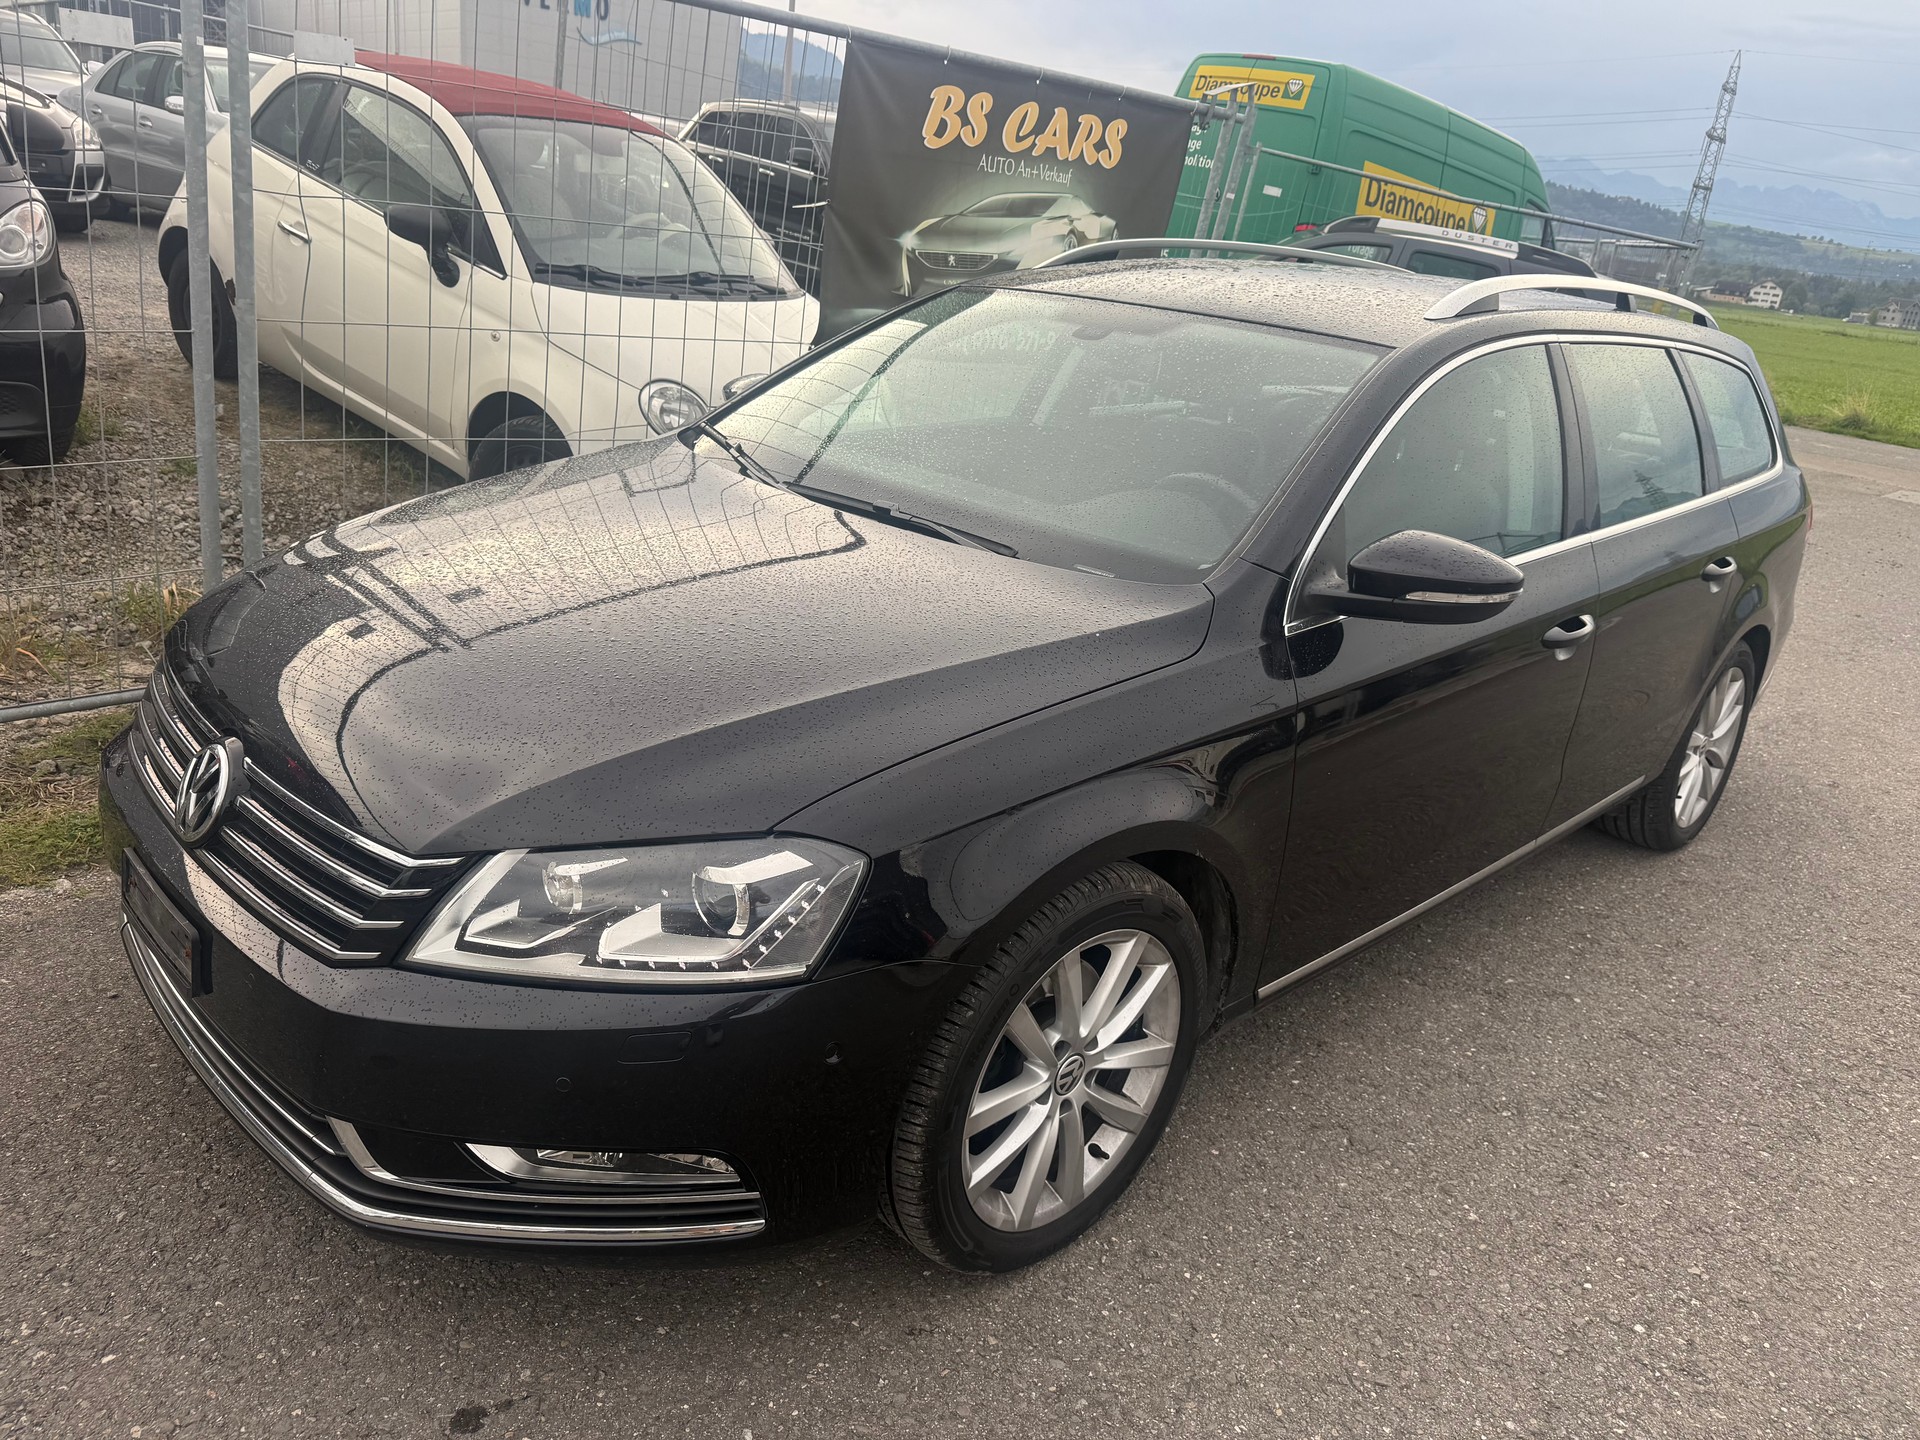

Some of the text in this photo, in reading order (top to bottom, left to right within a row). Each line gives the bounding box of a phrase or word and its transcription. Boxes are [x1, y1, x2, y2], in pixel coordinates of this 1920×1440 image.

[1195, 74, 1281, 101] Diaope
[922, 85, 1128, 169] BS CARS
[977, 153, 1015, 176] AUTO
[1442, 230, 1513, 250] DUSTER
